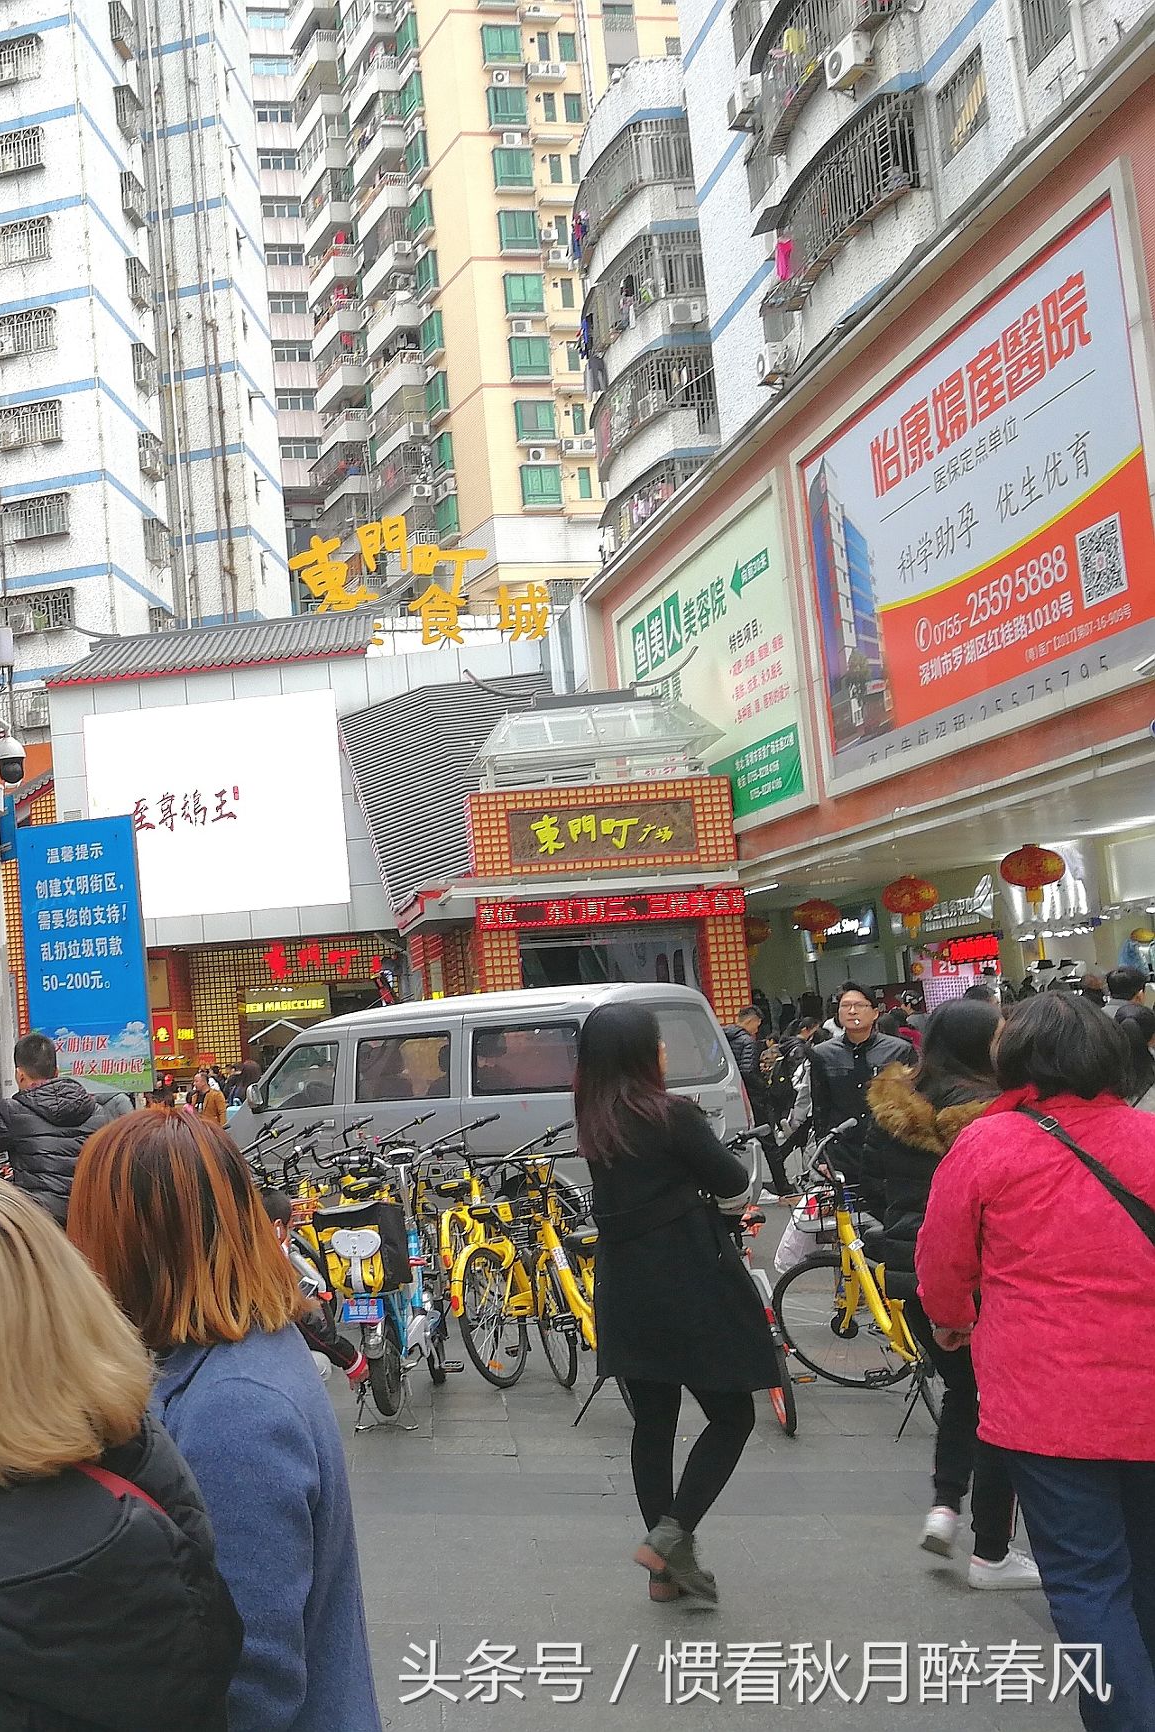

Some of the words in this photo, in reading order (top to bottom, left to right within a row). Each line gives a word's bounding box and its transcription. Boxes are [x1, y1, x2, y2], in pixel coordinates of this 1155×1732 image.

[933, 415, 1019, 494] 医保定点单位
[897, 501, 979, 584] 科学助孕
[996, 430, 1091, 524] 优生优育
[919, 590, 1075, 687] 深圳市罗湖区红桂路1018号
[46, 842, 104, 865] 温馨提示
[40, 935, 123, 962] 乱扔垃圾罚款
